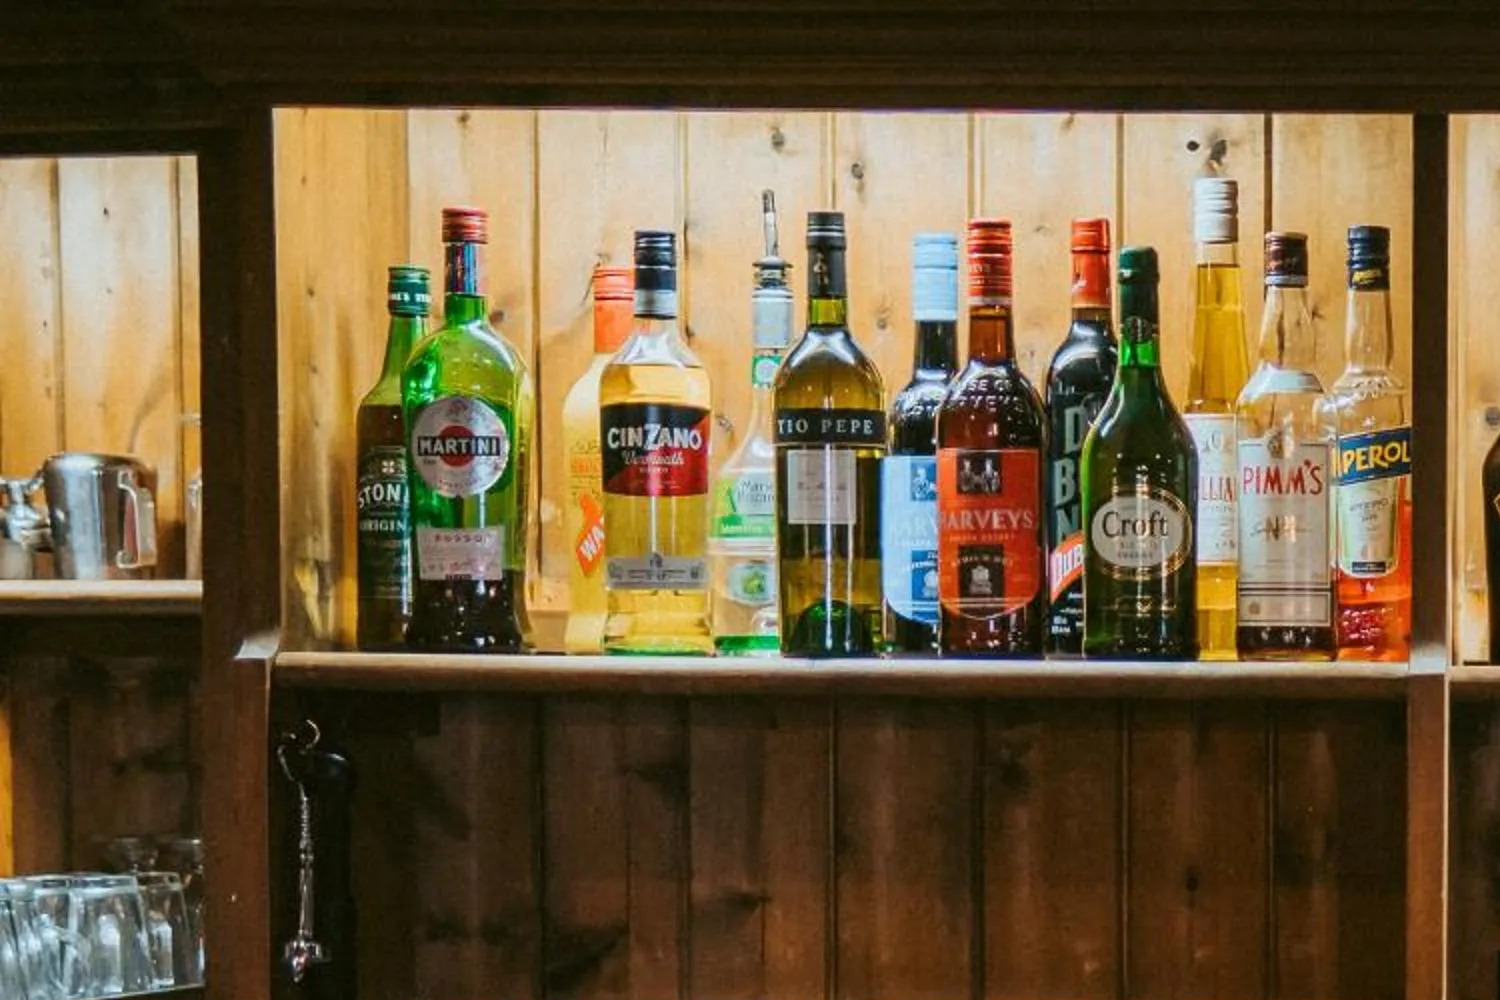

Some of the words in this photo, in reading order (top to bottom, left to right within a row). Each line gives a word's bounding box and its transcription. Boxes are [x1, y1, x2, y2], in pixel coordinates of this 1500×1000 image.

[607, 423, 702, 450] CINZANO
[777, 418, 809, 435] TIO
[821, 418, 874, 435] PEPE
[419, 438, 498, 454] MARTINI
[1243, 458, 1323, 496] PIMM'S
[359, 482, 408, 508] STON
[1102, 510, 1169, 538] Croft
